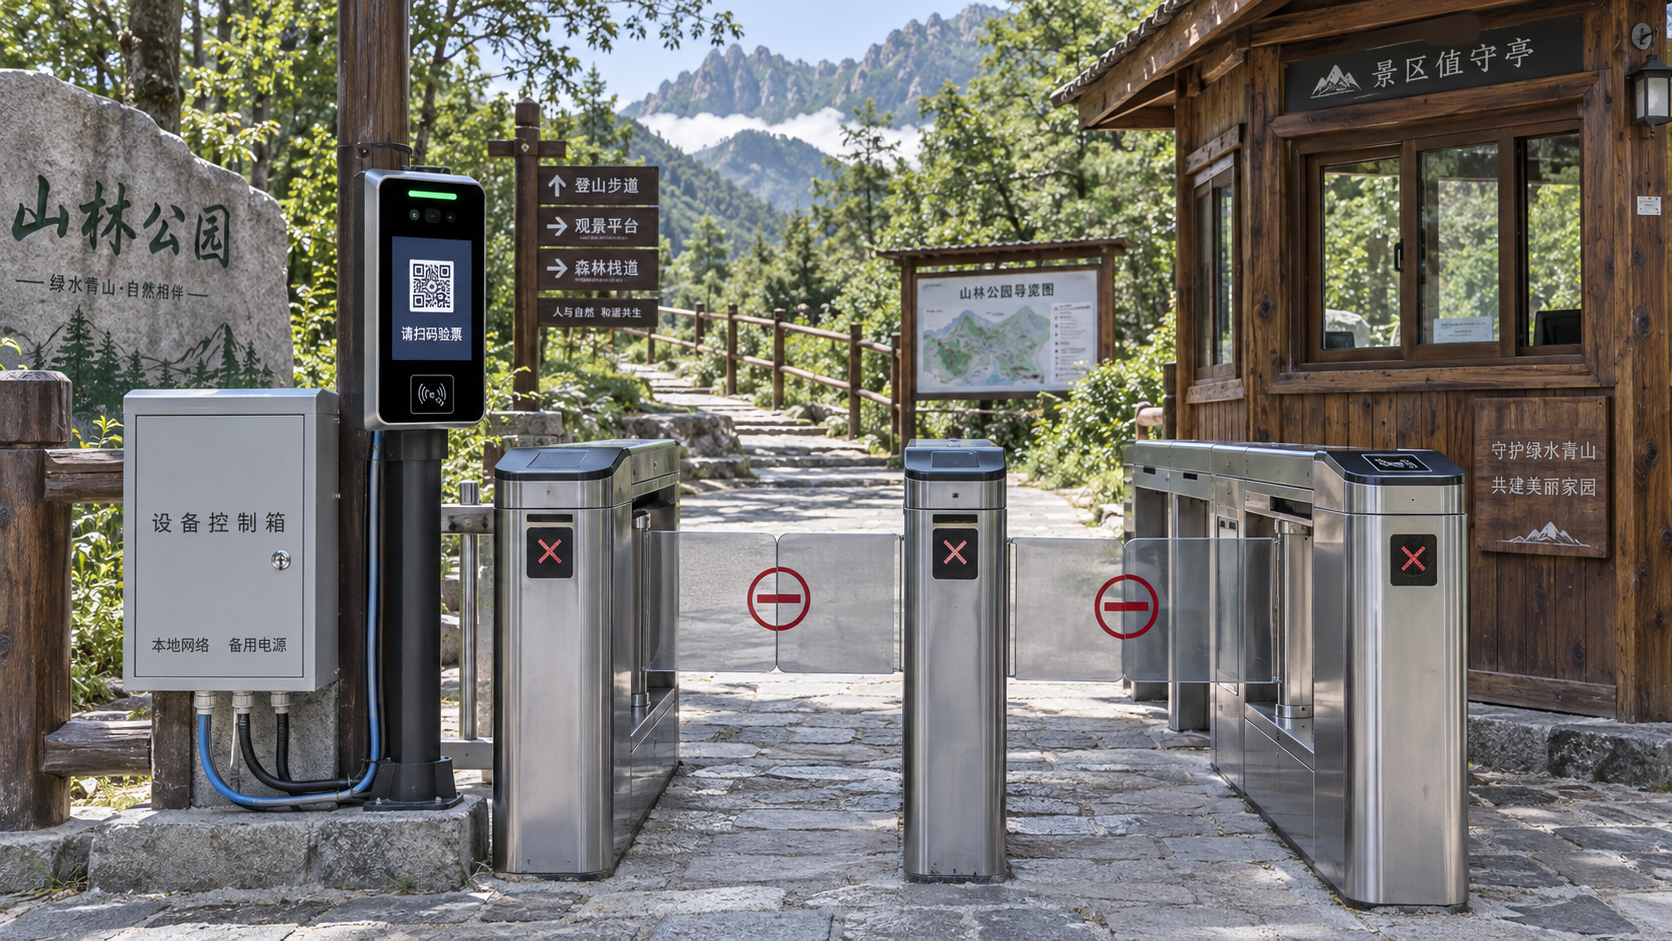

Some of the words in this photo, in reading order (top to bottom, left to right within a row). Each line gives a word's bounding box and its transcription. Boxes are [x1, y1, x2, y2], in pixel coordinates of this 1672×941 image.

[1371, 37, 1534, 88] 景区值守亭
[574, 177, 639, 194] 登山步道
[11, 174, 230, 269] 山林公园
[574, 217, 639, 234] 观景平台
[574, 259, 639, 276] 森林栈道
[401, 326, 463, 342] 请扫码验票
[1491, 440, 1597, 461] 守护绿水青山
[1491, 476, 1597, 498] 共建美丽家园
[151, 511, 286, 534] 设备控制箱
[151, 636, 210, 653] 本地网络
[228, 636, 288, 653] 备用电源
